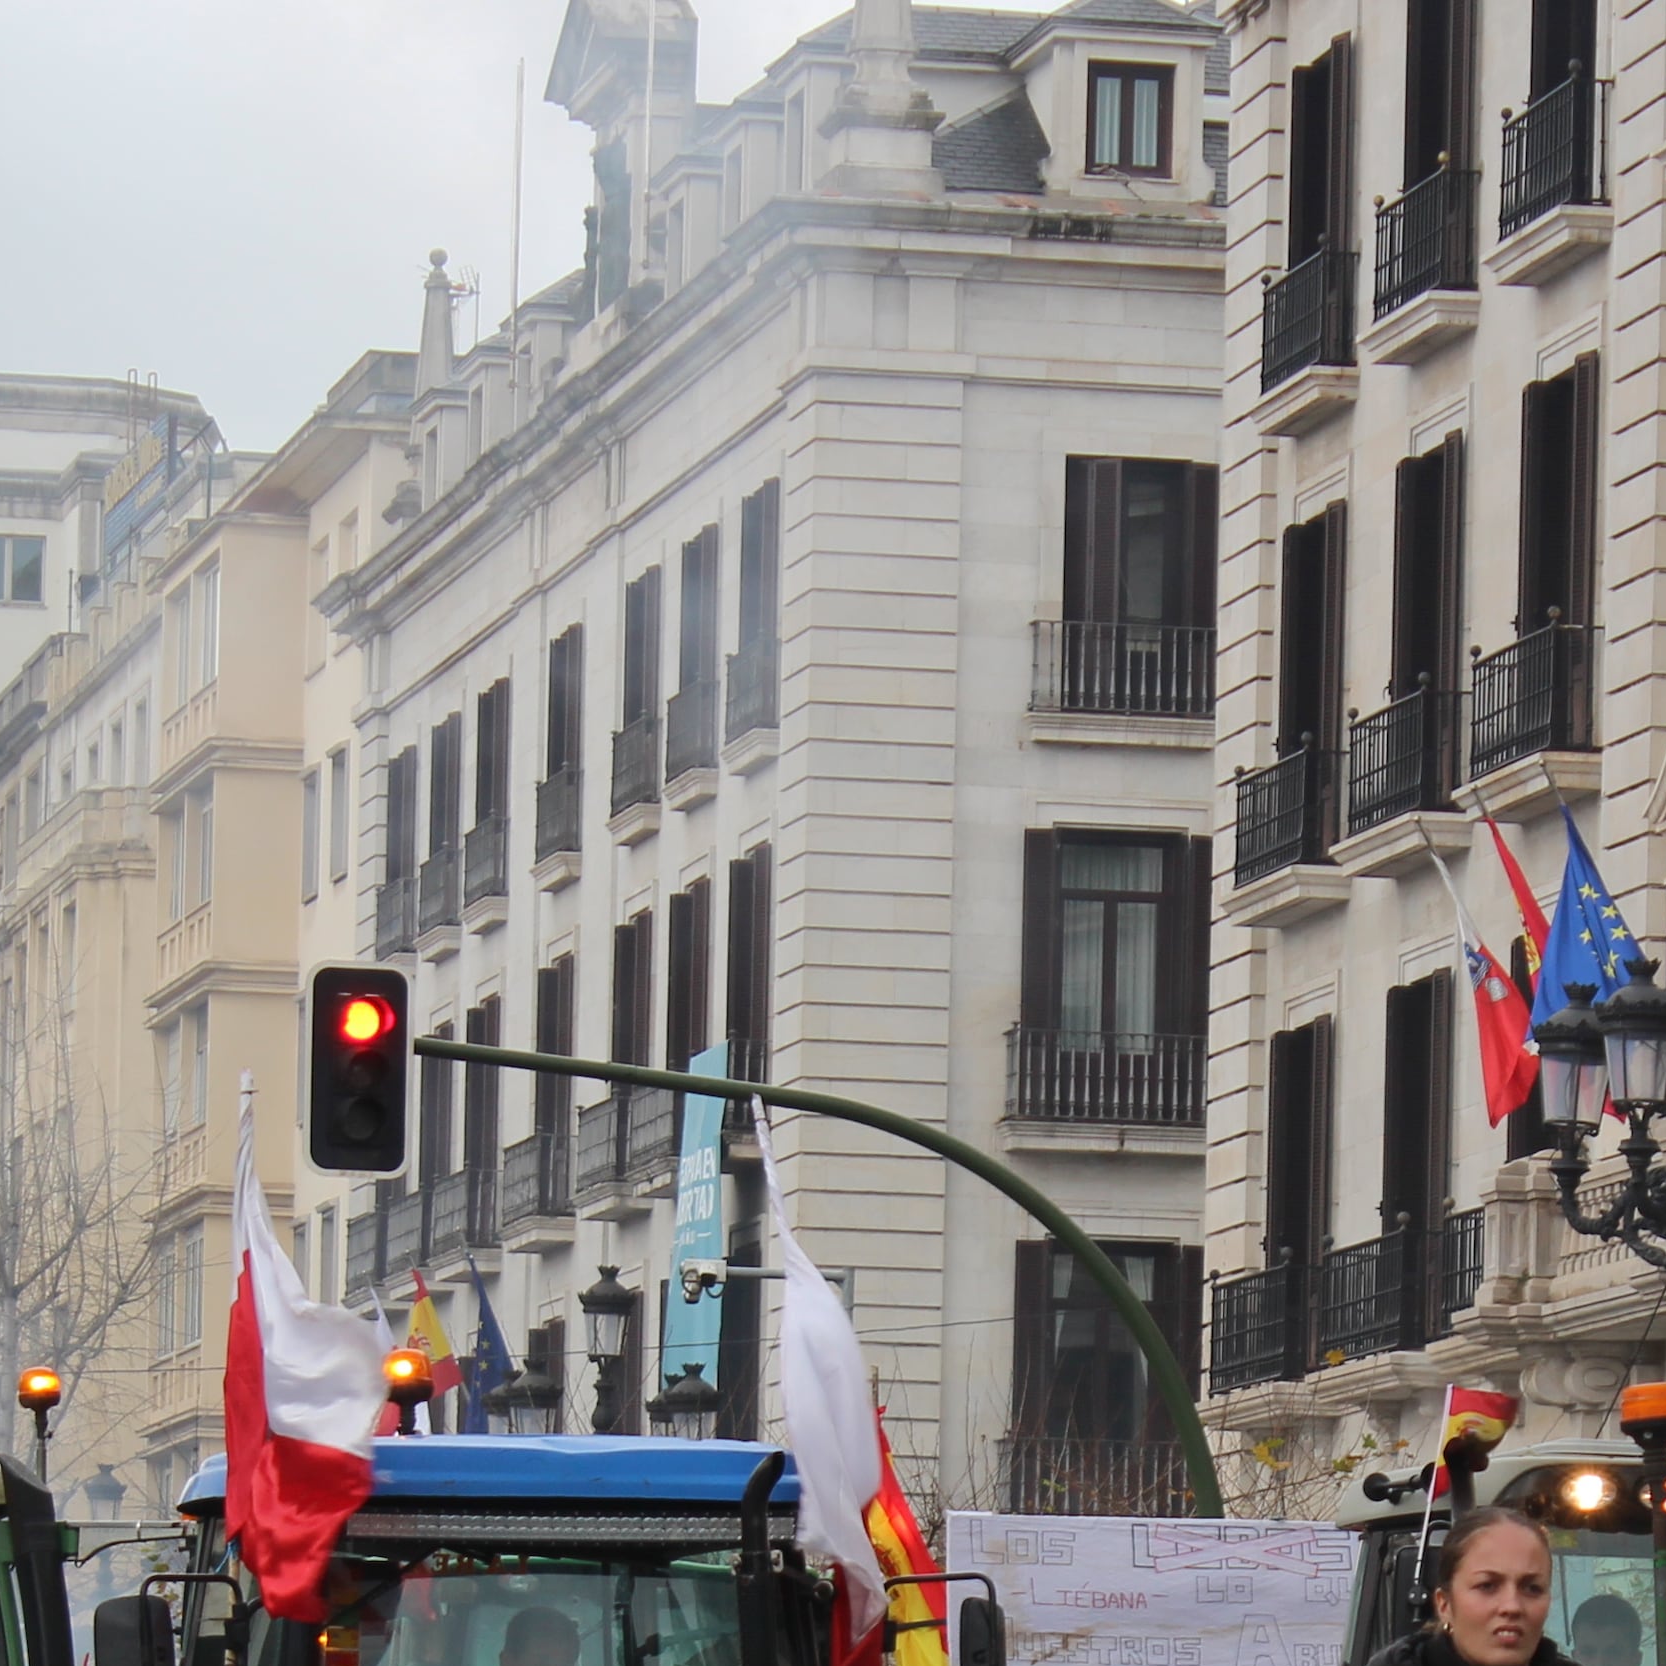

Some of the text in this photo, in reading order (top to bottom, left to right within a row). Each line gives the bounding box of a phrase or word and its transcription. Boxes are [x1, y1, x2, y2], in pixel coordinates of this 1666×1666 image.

[970, 1519, 1076, 1565] LOS
[1196, 1576, 1253, 1604] LO
[1005, 1616, 1202, 1666] UESTROS
